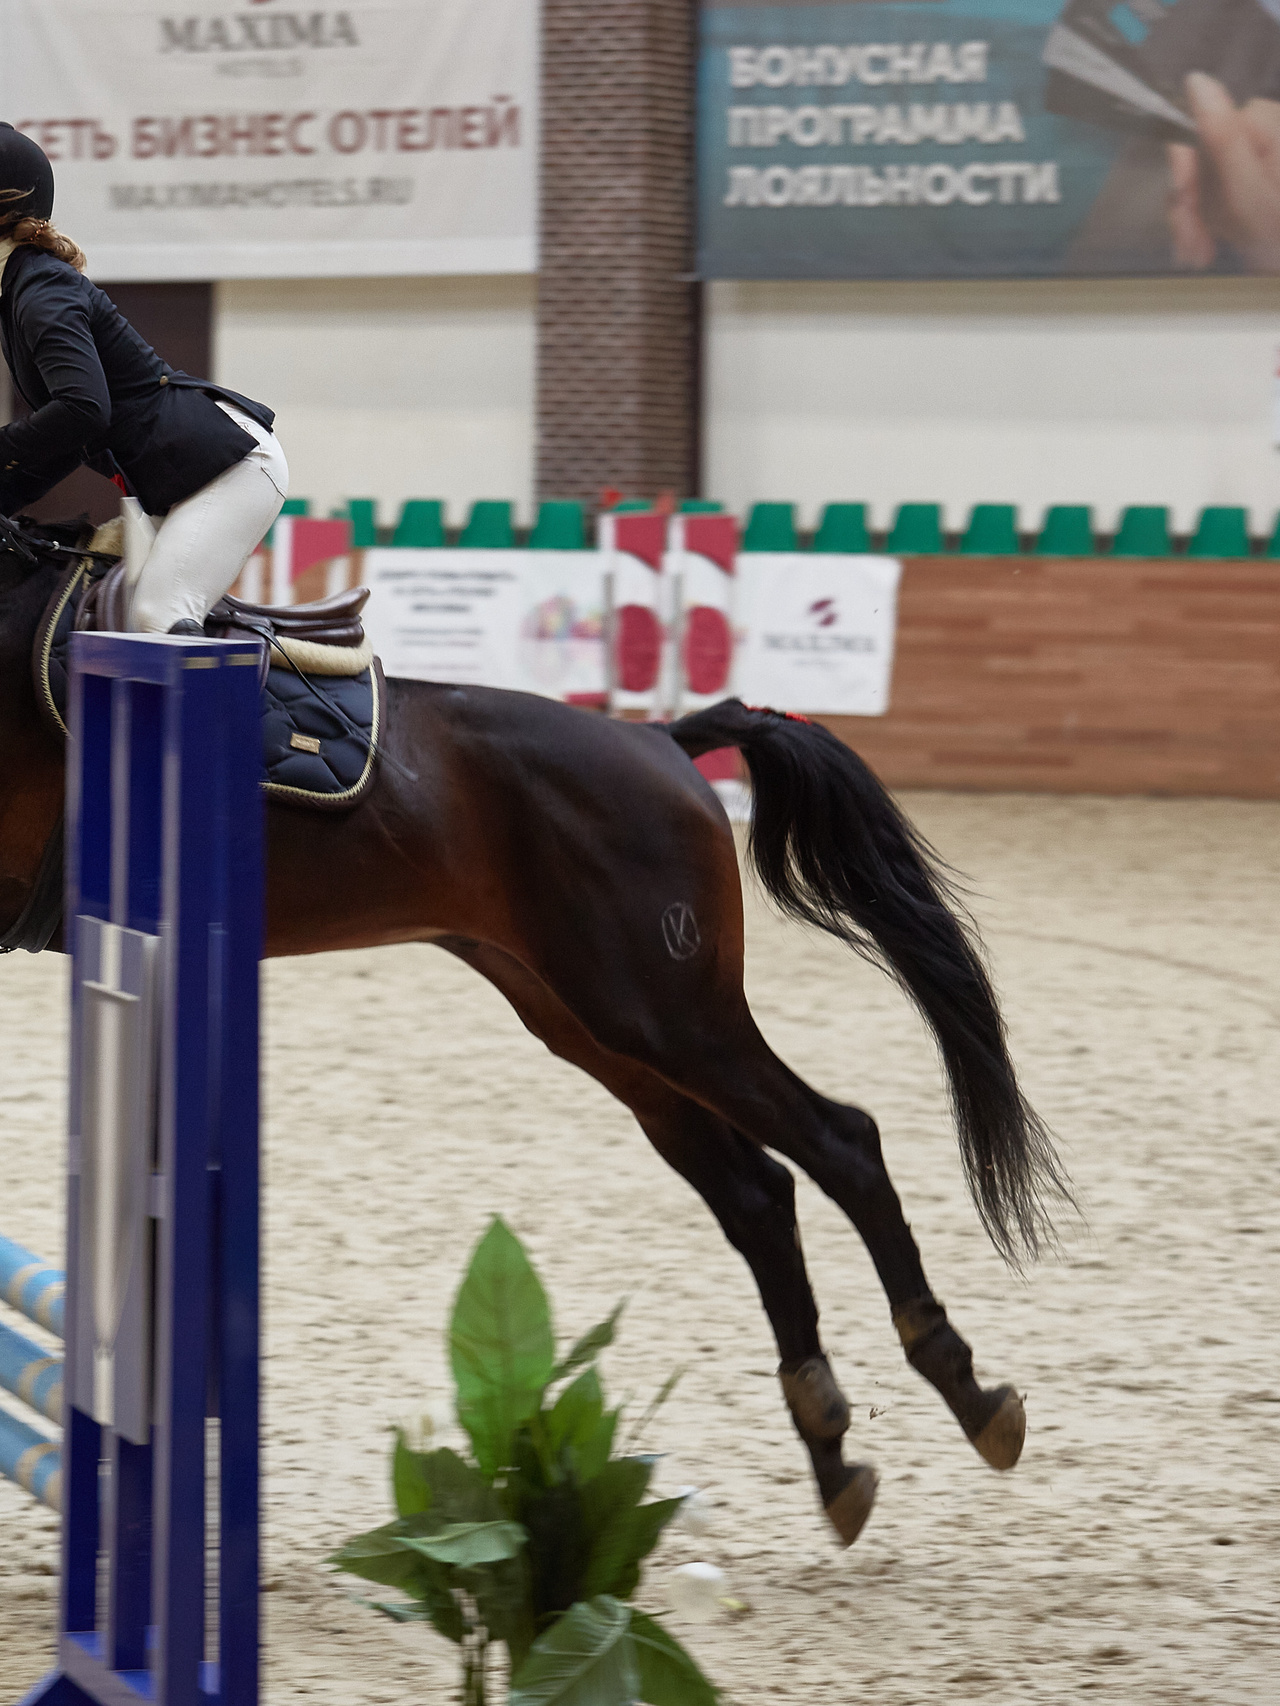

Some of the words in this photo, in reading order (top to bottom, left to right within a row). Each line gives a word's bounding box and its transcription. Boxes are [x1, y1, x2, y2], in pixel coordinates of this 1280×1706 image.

[158, 11, 360, 53] MAXIMA
[728, 42, 989, 88] БОНУСНАЯ
[131, 112, 318, 160] БИЗНЕС
[326, 94, 521, 156] ОТЕЛЕЙ
[726, 101, 1026, 148] ПРОГРАММА
[723, 161, 1061, 207] ЛОЯЛЬНОСТИ
